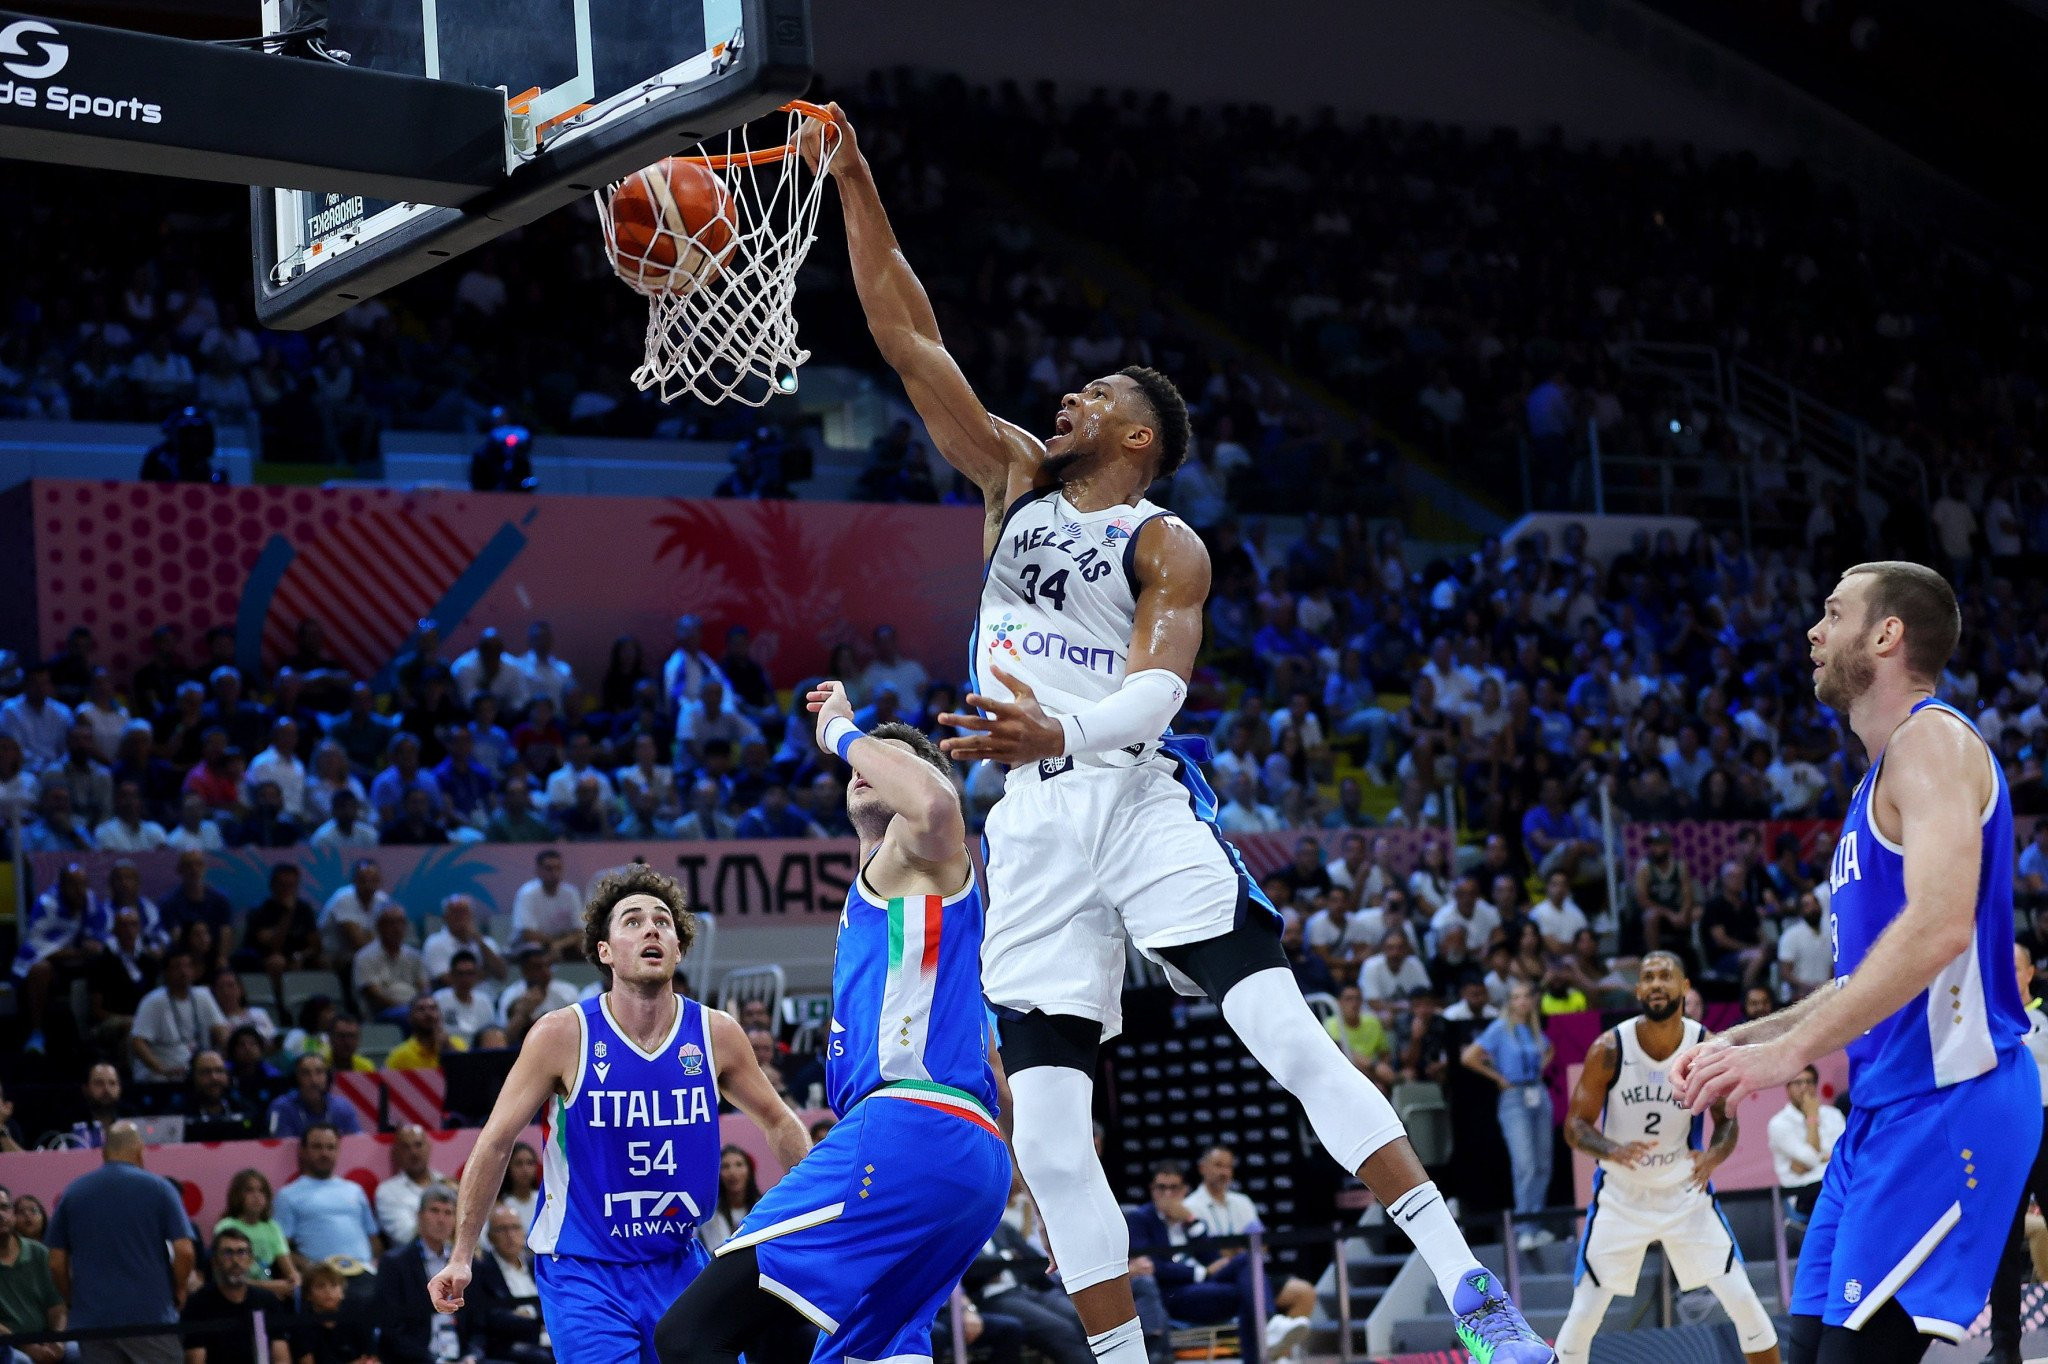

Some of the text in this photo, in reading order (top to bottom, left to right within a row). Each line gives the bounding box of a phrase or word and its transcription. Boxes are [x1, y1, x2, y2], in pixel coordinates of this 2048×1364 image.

[46, 86, 162, 124] Sports
[1013, 525, 1112, 583] HELLAS
[1020, 564, 1070, 611] 34
[634, 852, 853, 913] IMAS
[587, 1086, 710, 1127] ITALIA
[1644, 1112, 1661, 1135] 2
[628, 1140, 677, 1176] 54
[604, 1191, 701, 1218] ITA
[610, 1220, 694, 1238] AIRWAY
